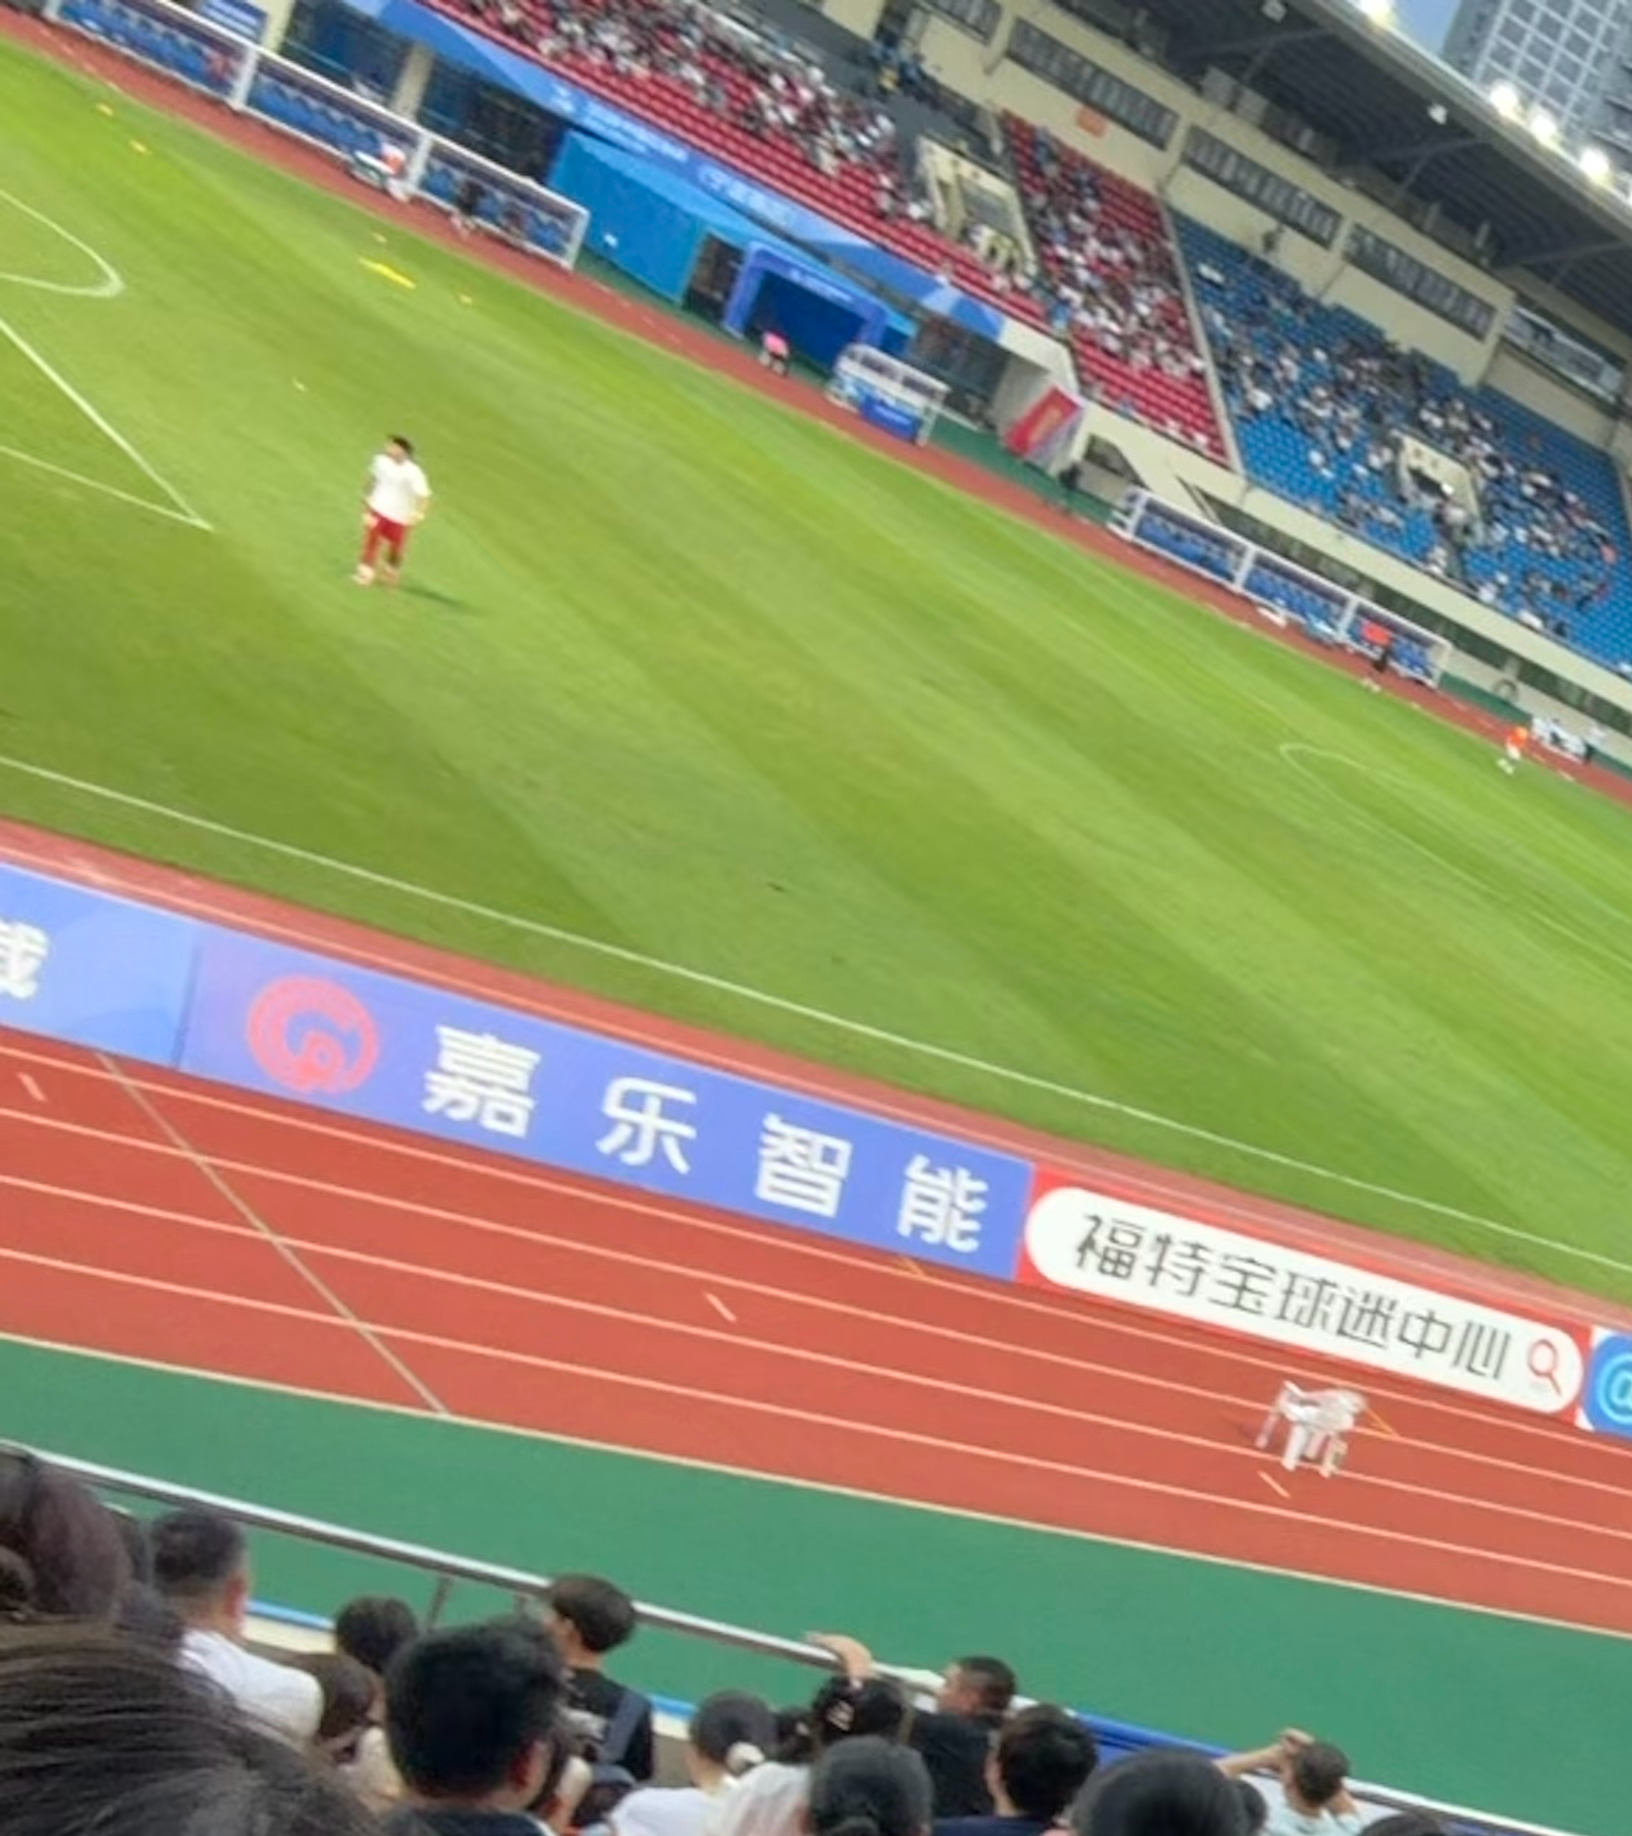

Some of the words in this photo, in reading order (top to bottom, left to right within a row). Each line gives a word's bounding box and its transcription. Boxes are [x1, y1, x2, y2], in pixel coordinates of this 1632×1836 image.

[422, 1022, 991, 1254] 嘉乐智能
[1074, 1211, 1511, 1380] 福特宝球迷中心
